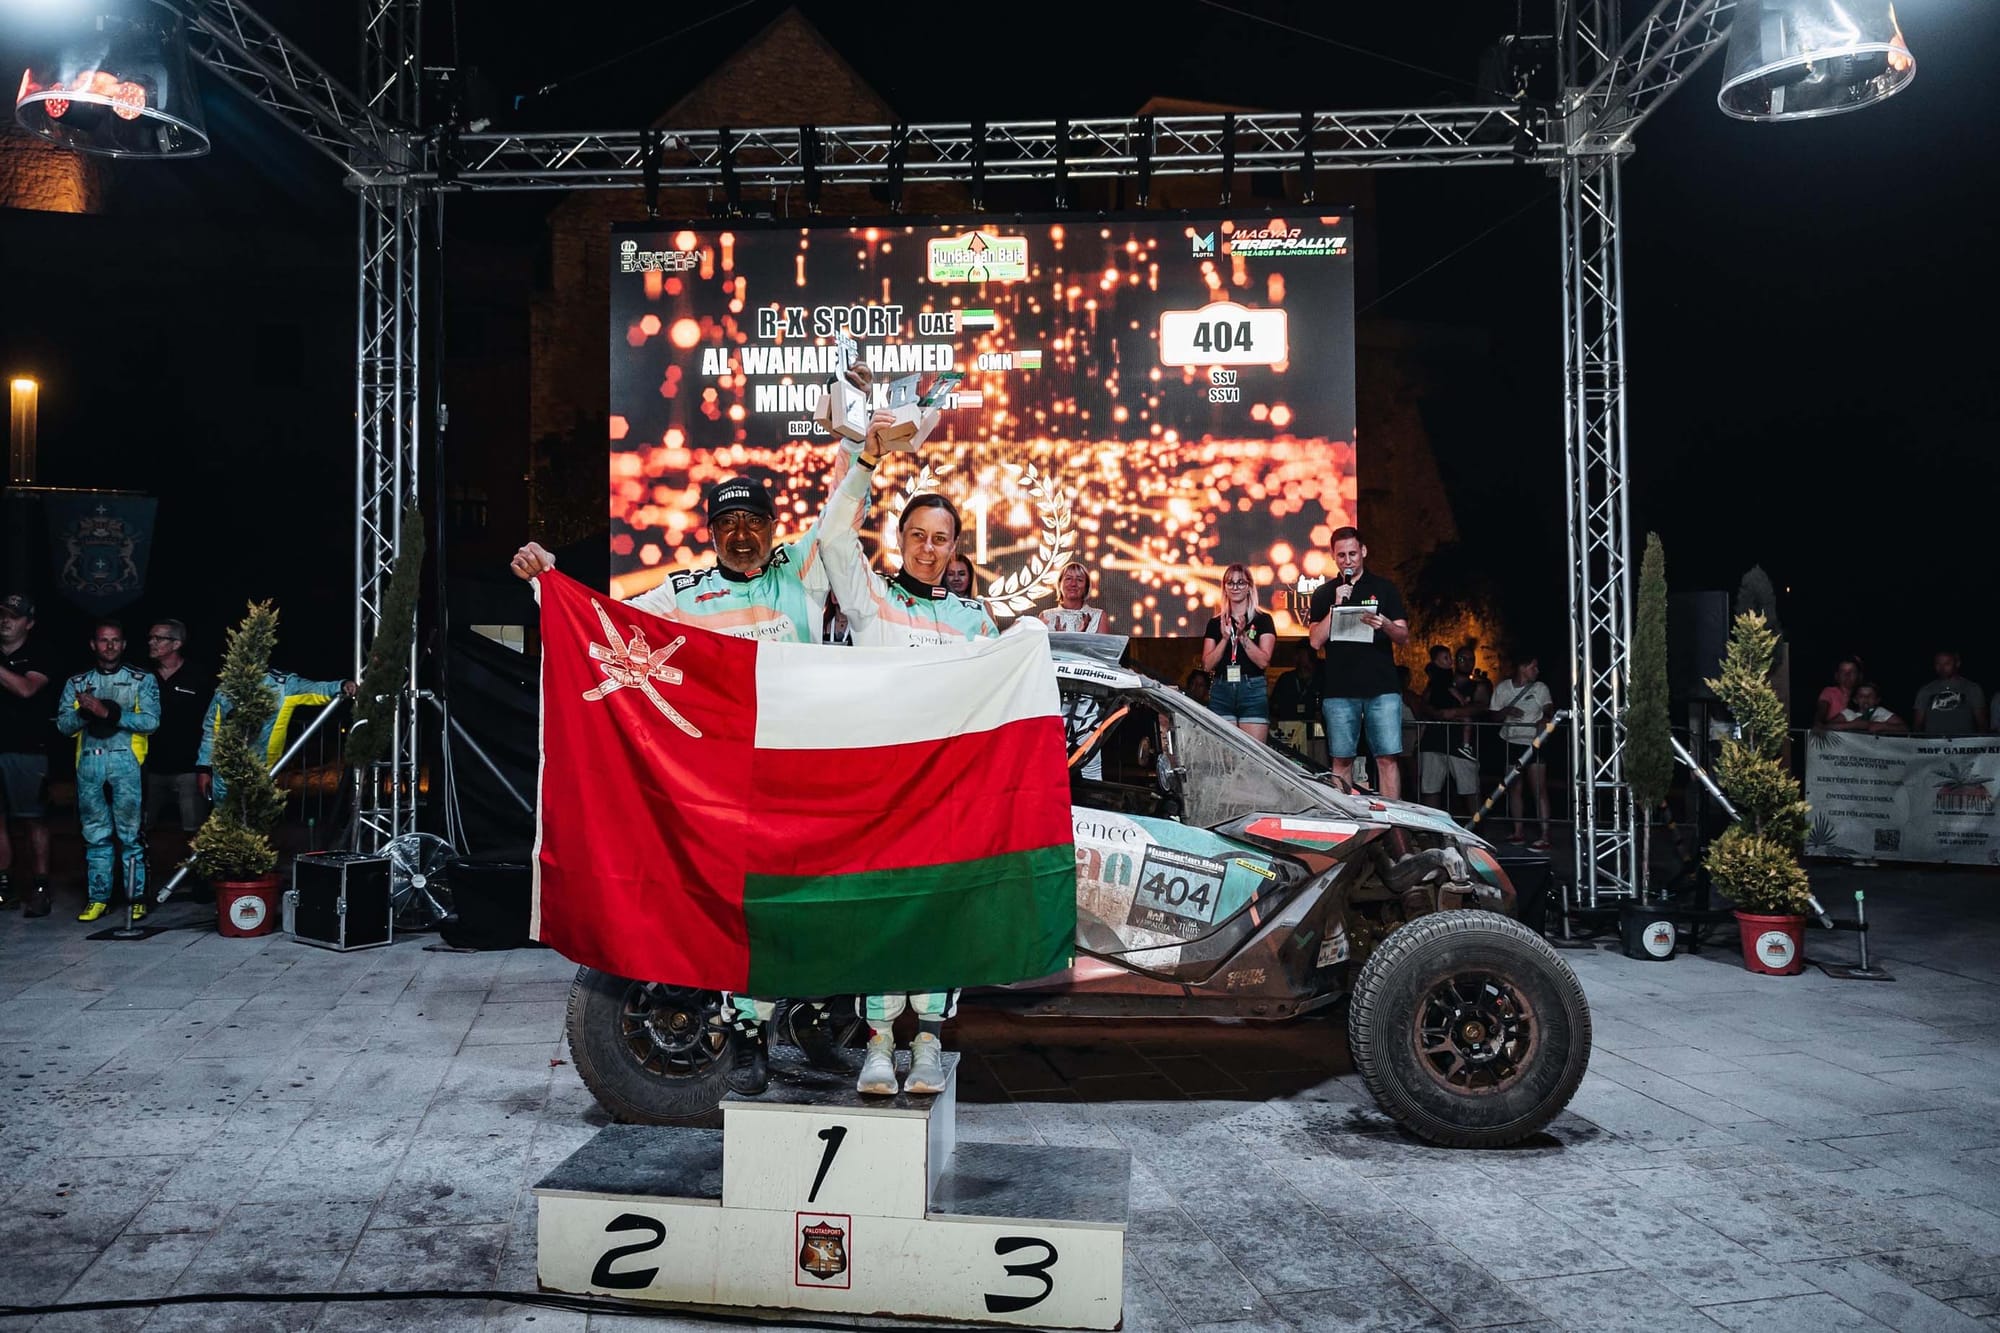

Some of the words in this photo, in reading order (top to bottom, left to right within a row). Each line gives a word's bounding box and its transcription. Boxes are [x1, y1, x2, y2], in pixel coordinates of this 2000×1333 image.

[1232, 229, 1301, 239] MAGYAR
[1230, 237, 1347, 250] TEREP-RALLYE
[621, 251, 707, 262] EUROPEAN
[1230, 249, 1273, 257] ORSZÁGOS
[1275, 248, 1324, 256] BAJNOKSÁG
[621, 261, 663, 272] BAJA
[664, 260, 696, 272] CUP
[759, 308, 805, 338] R-X
[814, 305, 902, 337] SPORT
[919, 313, 956, 335] UAE
[1193, 321, 1253, 352] 404
[702, 347, 732, 376] AL
[866, 344, 953, 372] HAMED
[978, 353, 1013, 370] OMN
[1212, 371, 1237, 384] SSV
[1209, 388, 1240, 402] SSV1
[789, 422, 812, 436] BRP
[719, 489, 750, 503] oman
[1057, 665, 1071, 674] AL
[1073, 667, 1118, 681] WAHAIBI
[1142, 871, 1211, 913] 404
[808, 1126, 848, 1203] 1
[590, 1213, 667, 1290] 2
[984, 1236, 1059, 1314] 3
